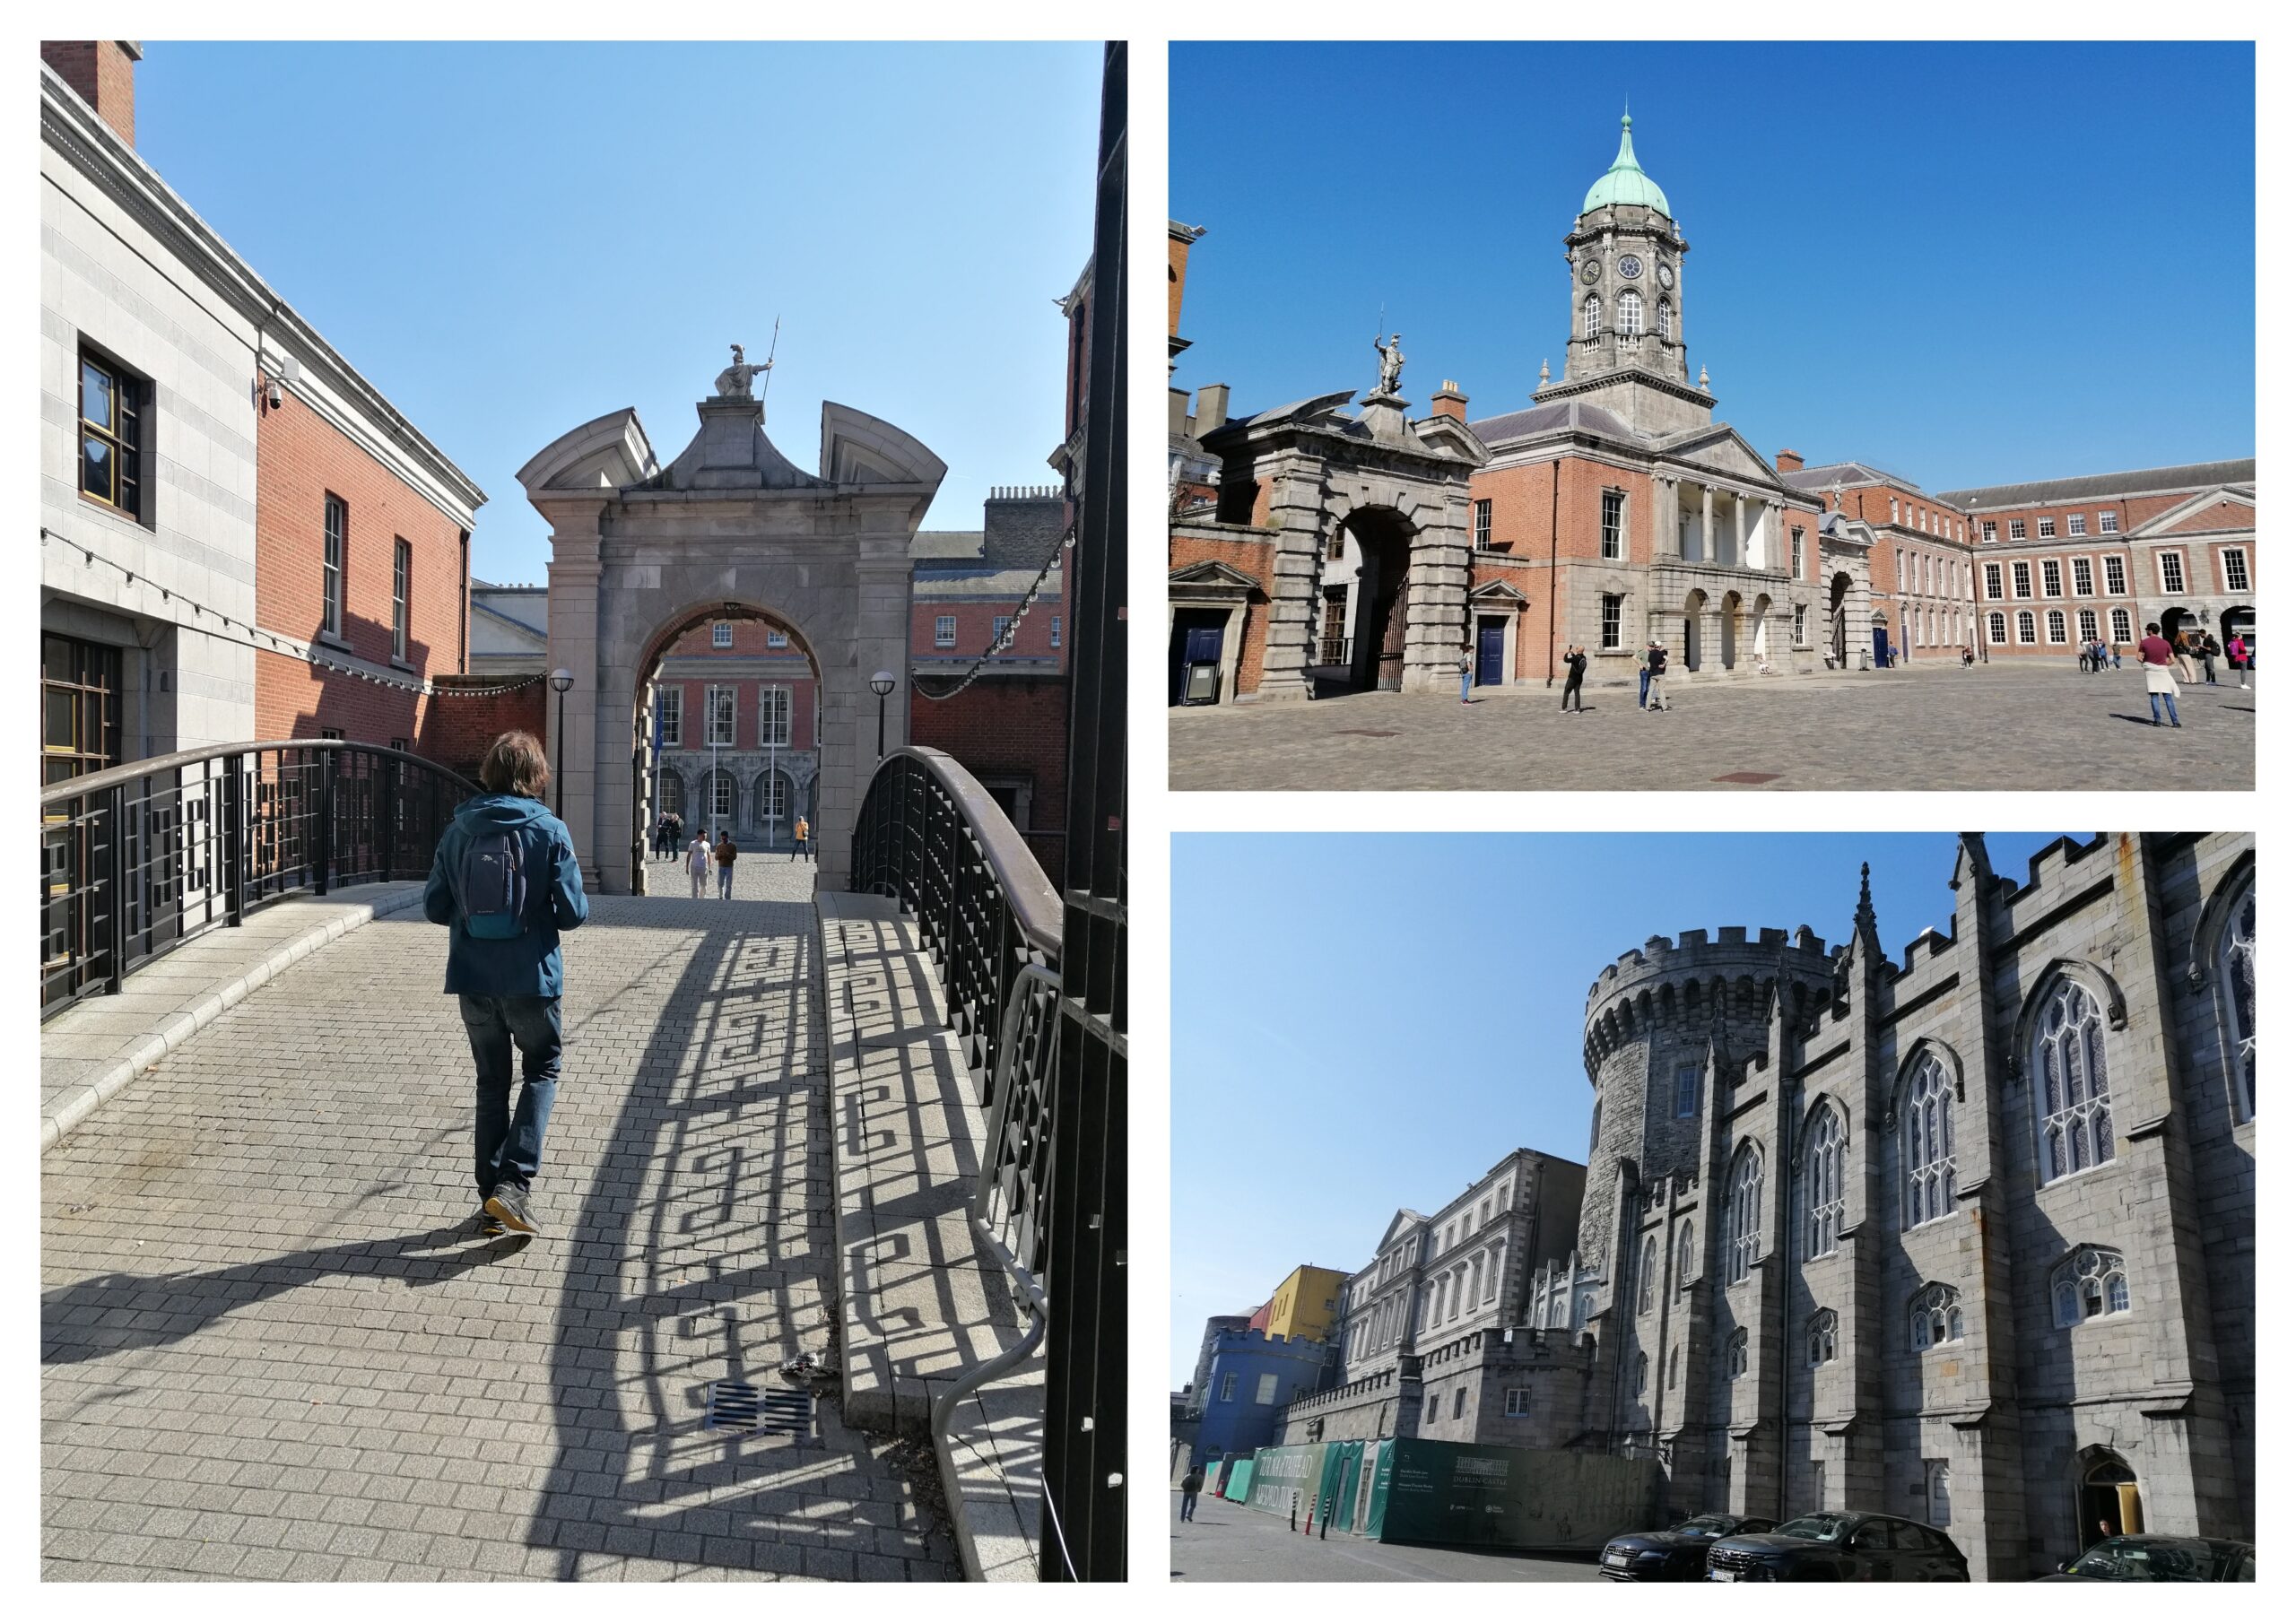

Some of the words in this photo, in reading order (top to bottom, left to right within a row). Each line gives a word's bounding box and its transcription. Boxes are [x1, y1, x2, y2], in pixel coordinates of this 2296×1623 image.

[1453, 1476, 1481, 1484] DUBLIN
[1483, 1478, 1508, 1486] CASTLE
[1256, 1483, 1279, 1506] RECORD
